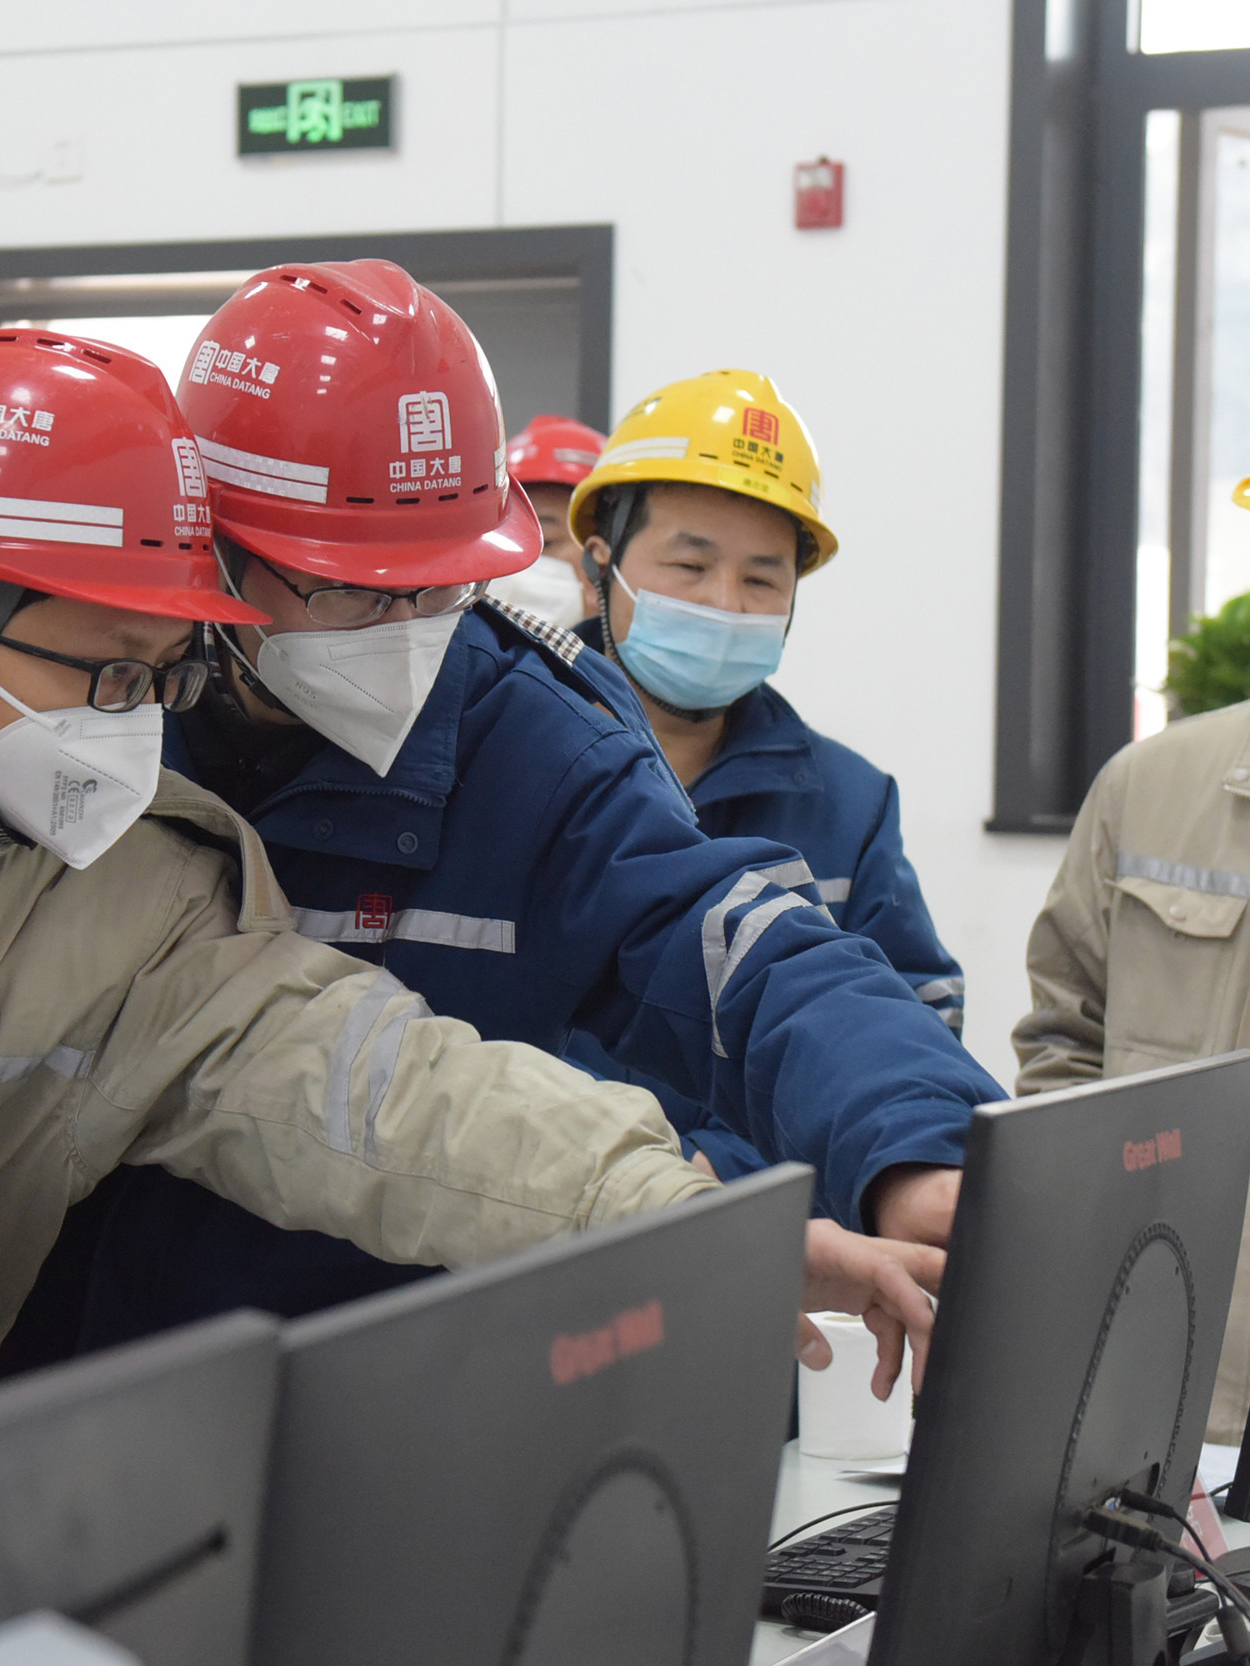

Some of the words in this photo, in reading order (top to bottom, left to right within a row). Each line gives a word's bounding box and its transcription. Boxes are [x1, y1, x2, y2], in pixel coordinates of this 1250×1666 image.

[215, 349, 281, 384] 中国大唐
[210, 372, 232, 387] CHINA
[232, 378, 271, 399] DATANG
[389, 455, 461, 479] 中国大唐
[390, 480, 422, 493] CHINA
[424, 477, 462, 490] DATANG
[174, 526, 195, 536] CHINA
